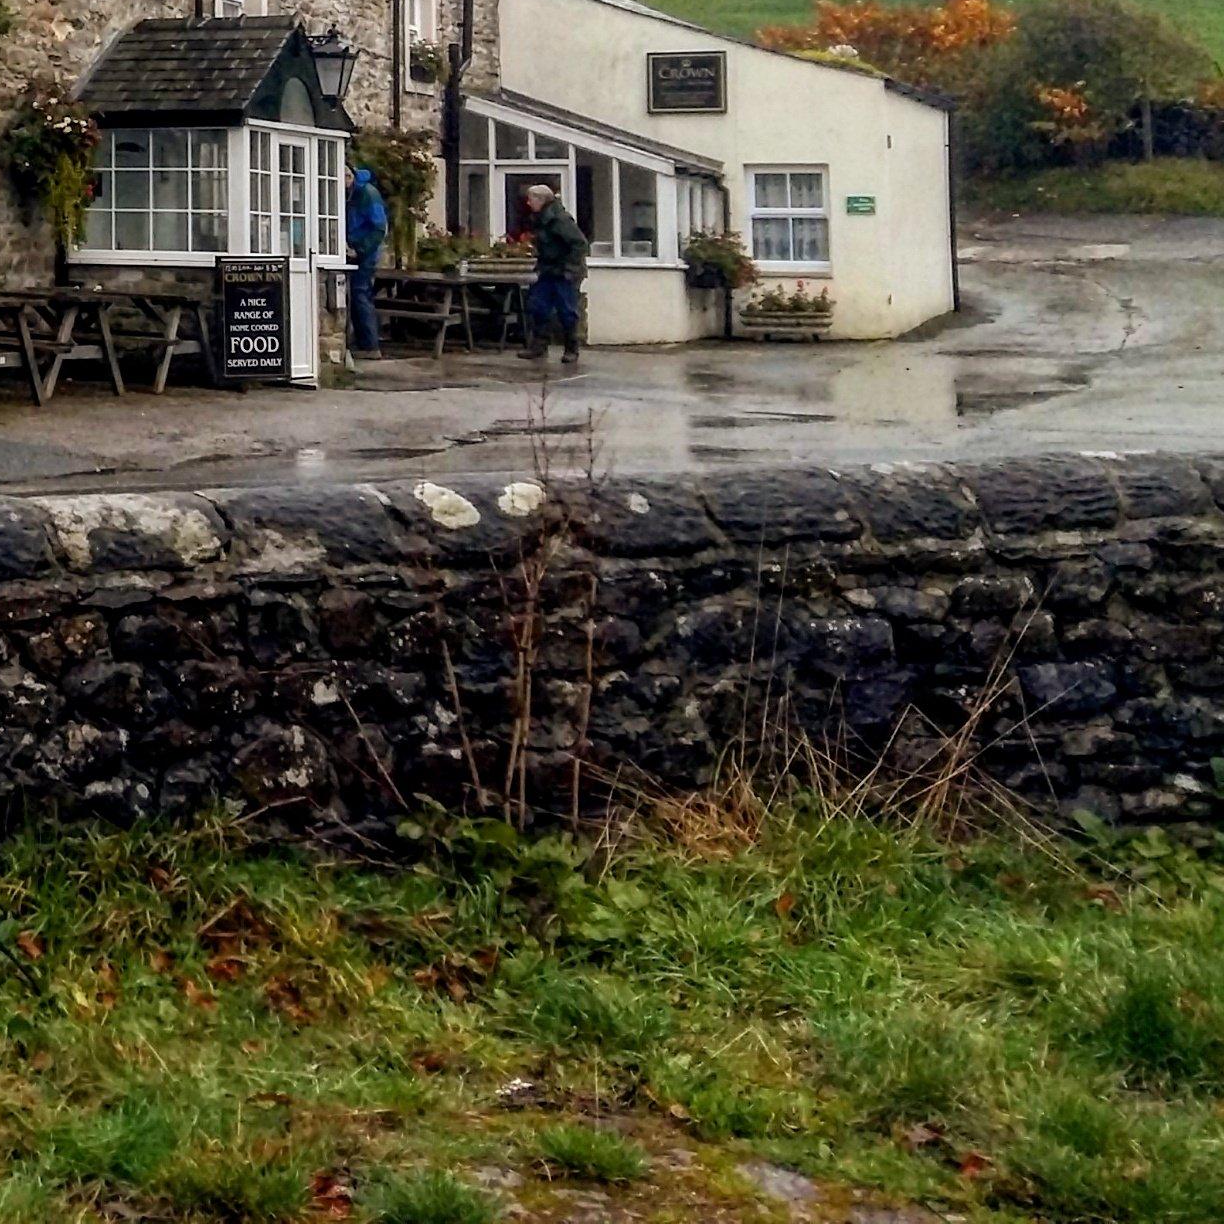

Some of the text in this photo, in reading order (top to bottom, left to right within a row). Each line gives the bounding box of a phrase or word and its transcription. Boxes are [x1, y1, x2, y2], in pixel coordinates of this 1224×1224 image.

[658, 67, 715, 80] CROWN
[225, 272, 283, 283] CROWN INN
[240, 298, 267, 307] A NICE
[234, 311, 274, 320] RANGE OF
[230, 323, 279, 332] HOME COOKED
[230, 336, 280, 354] FOOD
[227, 358, 282, 368] SERVED DAILY
